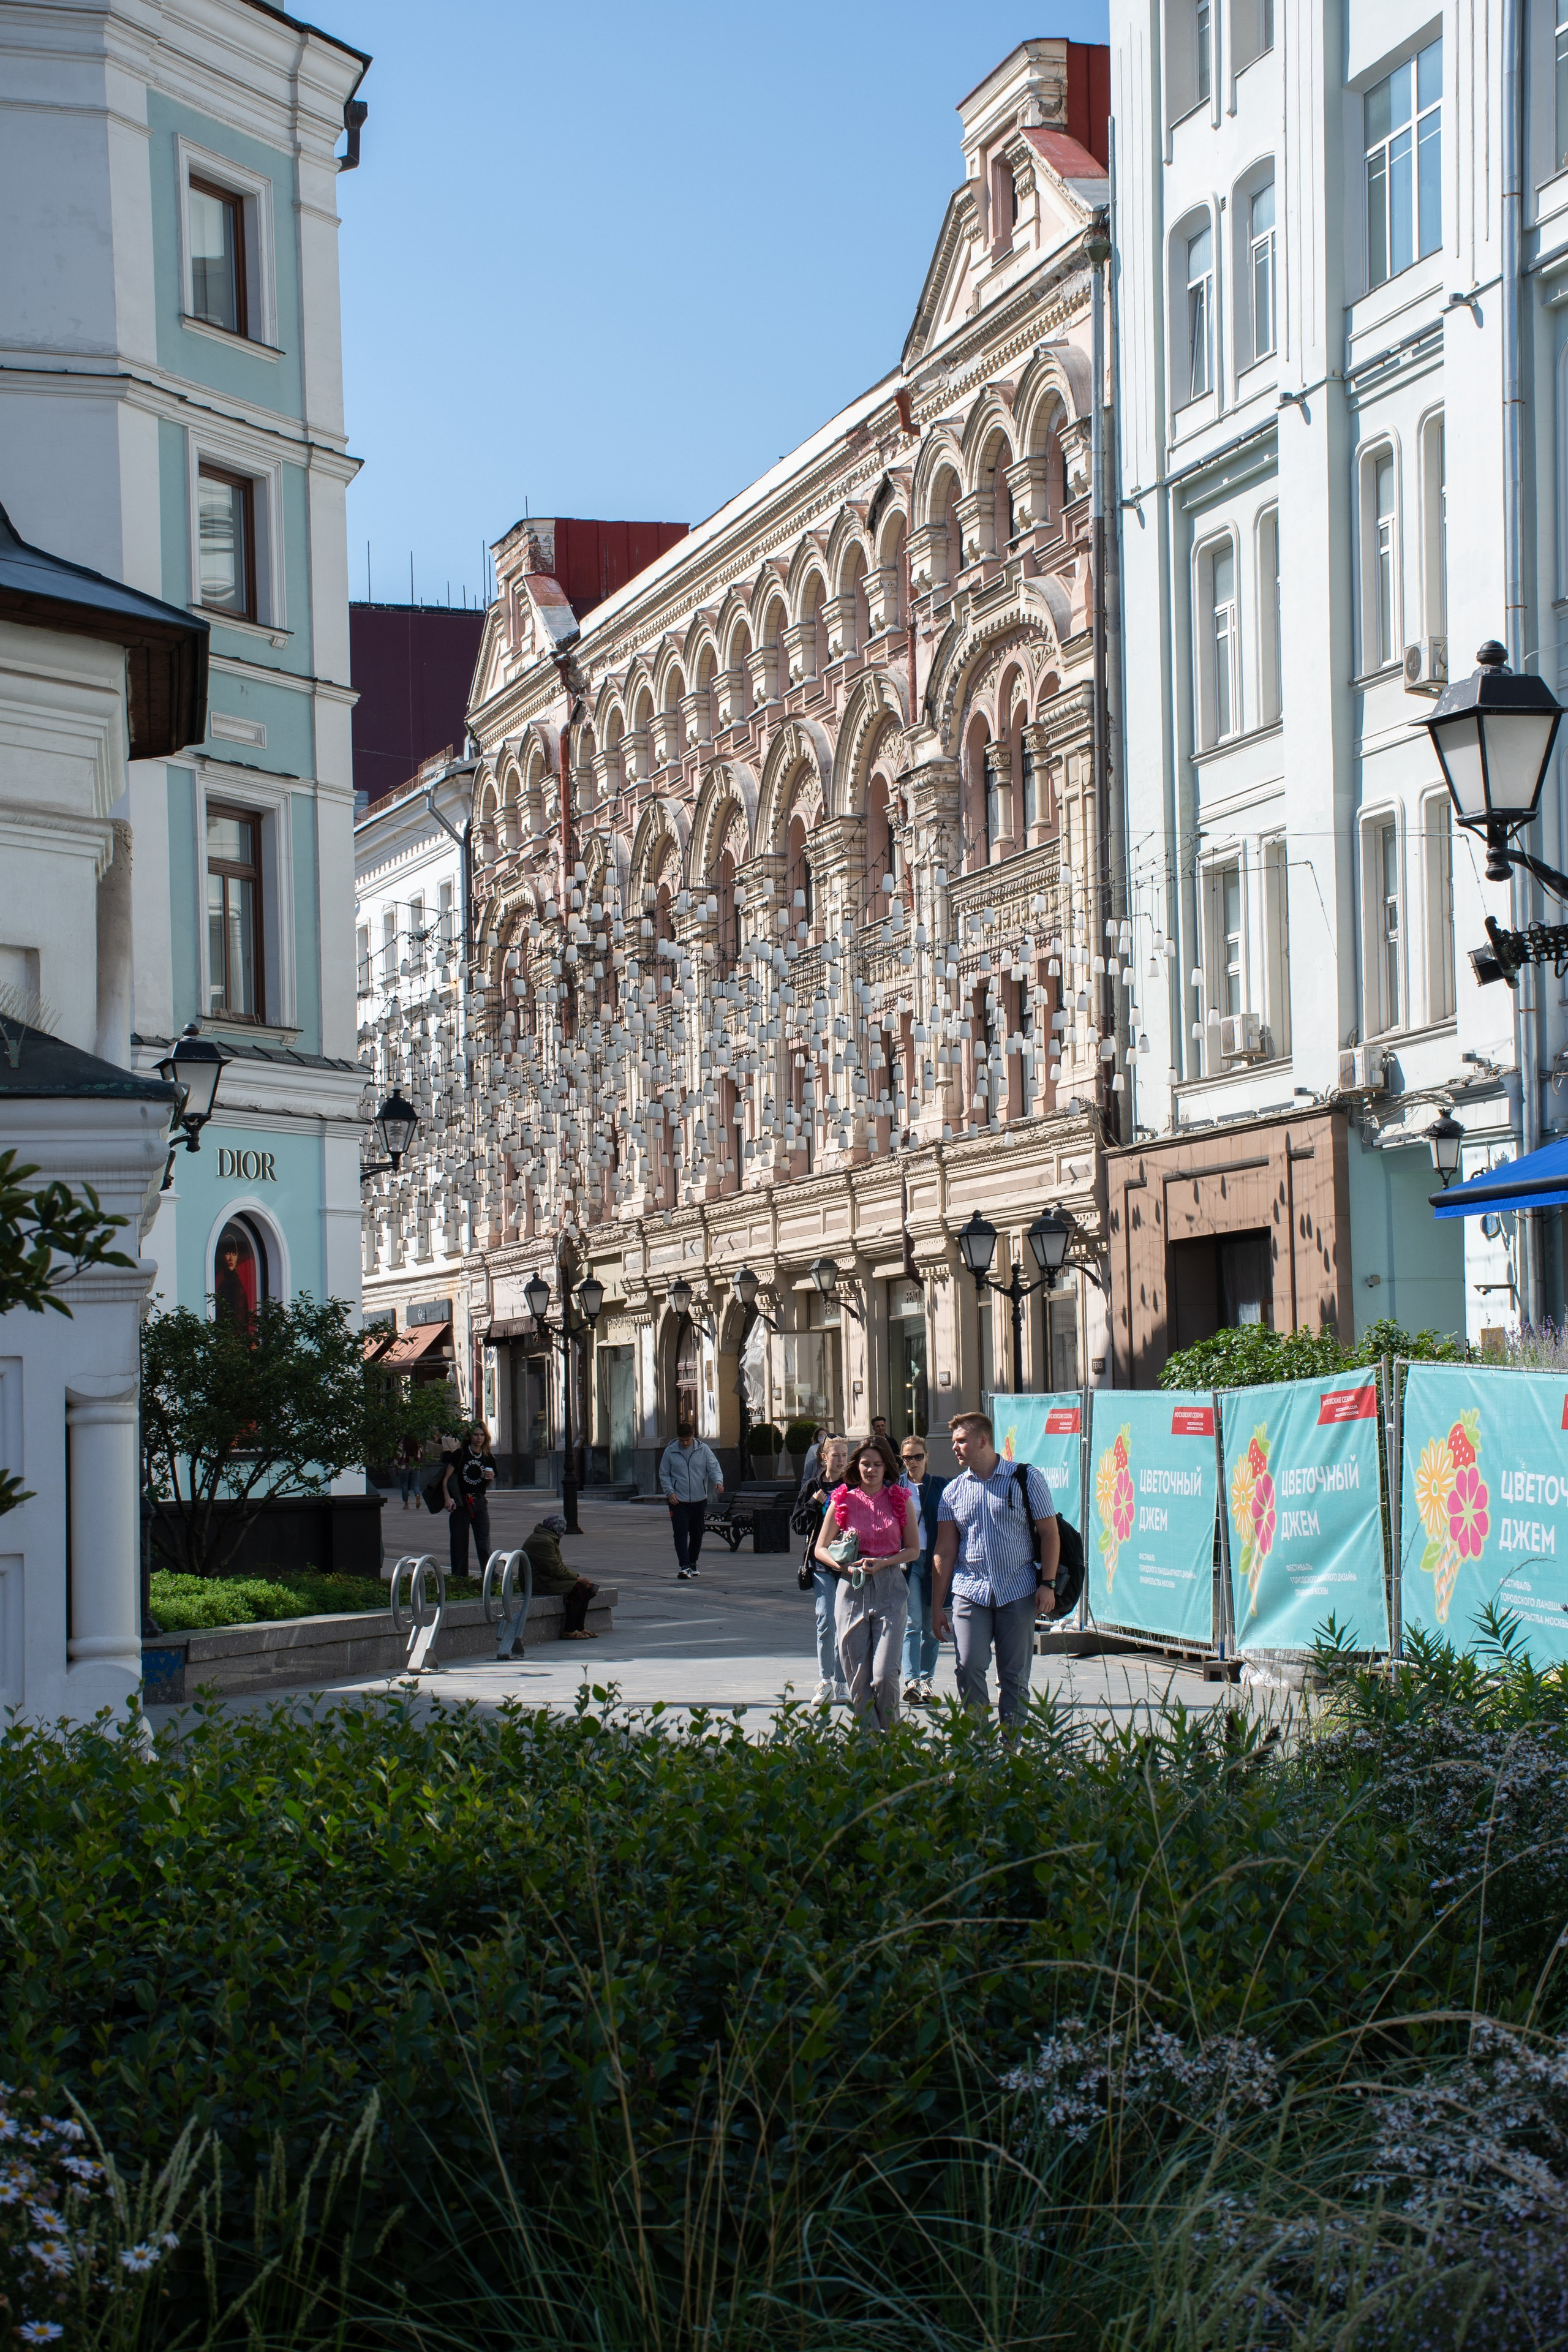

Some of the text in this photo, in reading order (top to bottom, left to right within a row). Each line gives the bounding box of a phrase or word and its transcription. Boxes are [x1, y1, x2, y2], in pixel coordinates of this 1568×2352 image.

[215, 1148, 278, 1182] DIOR
[1488, 1217, 1493, 1231] 3
[1093, 1361, 1103, 1370] FENDI
[462, 1475, 483, 1485] MOSCOW
[1139, 1465, 1202, 1496] ЦВЕТОЧНЫЙ
[1281, 1454, 1360, 1498] ЦВЕТОЧНЫЙ
[1139, 1506, 1168, 1532] ДЖЕМ
[1281, 1509, 1321, 1541] ДЖЕМ
[1498, 1517, 1555, 1555] ДЖЕМ
[1286, 1563, 1313, 1572] ФЕСТИВАЛЬ
[1337, 1571, 1357, 1582] ДИЗАЙНА
[1499, 1578, 1532, 1591] ФЕСТИВАЛЬ
[1500, 1592, 1535, 1607] ГОРОДСКОГО
